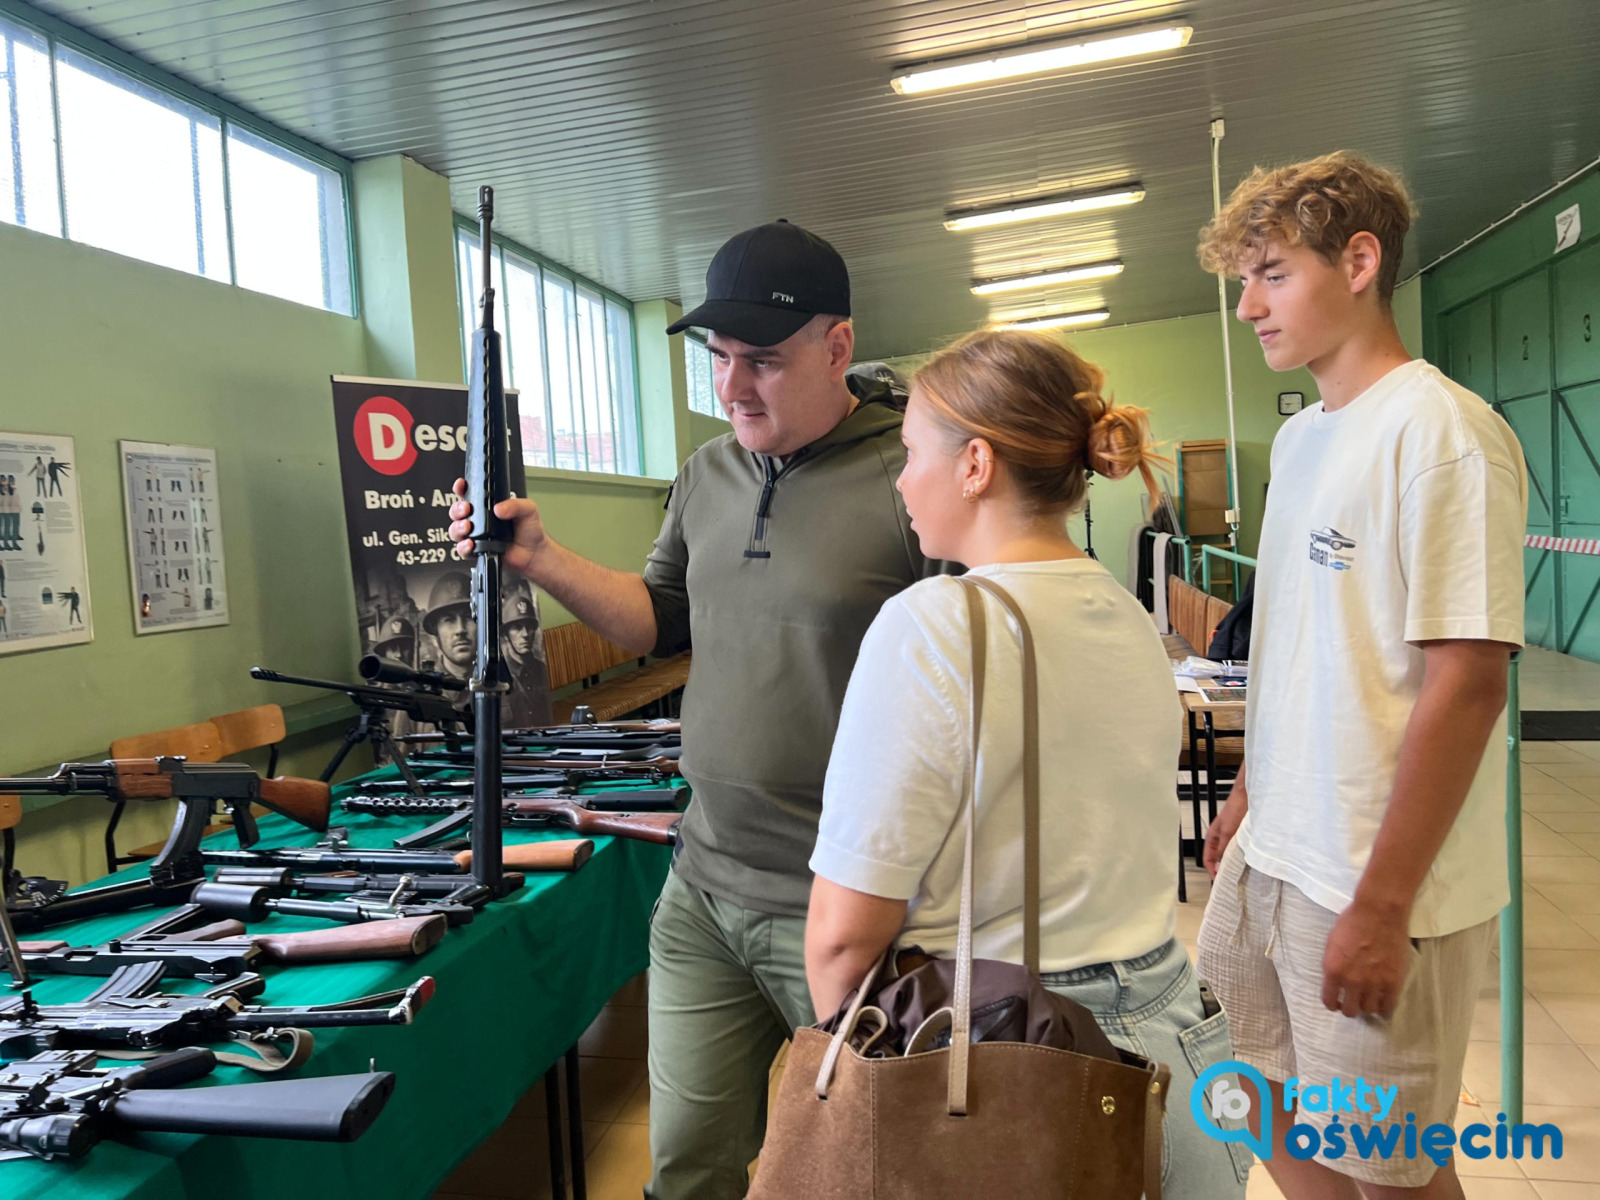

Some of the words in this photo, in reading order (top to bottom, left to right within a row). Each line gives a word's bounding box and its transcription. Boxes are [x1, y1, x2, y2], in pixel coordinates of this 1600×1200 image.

[772, 291, 794, 304] FTN
[1583, 313, 1592, 343] 3
[1522, 335, 1529, 361] 2
[364, 489, 414, 509] Broń
[362, 531, 384, 547] ul.
[388, 530, 423, 545] Gen.
[396, 547, 446, 565] 43-229
